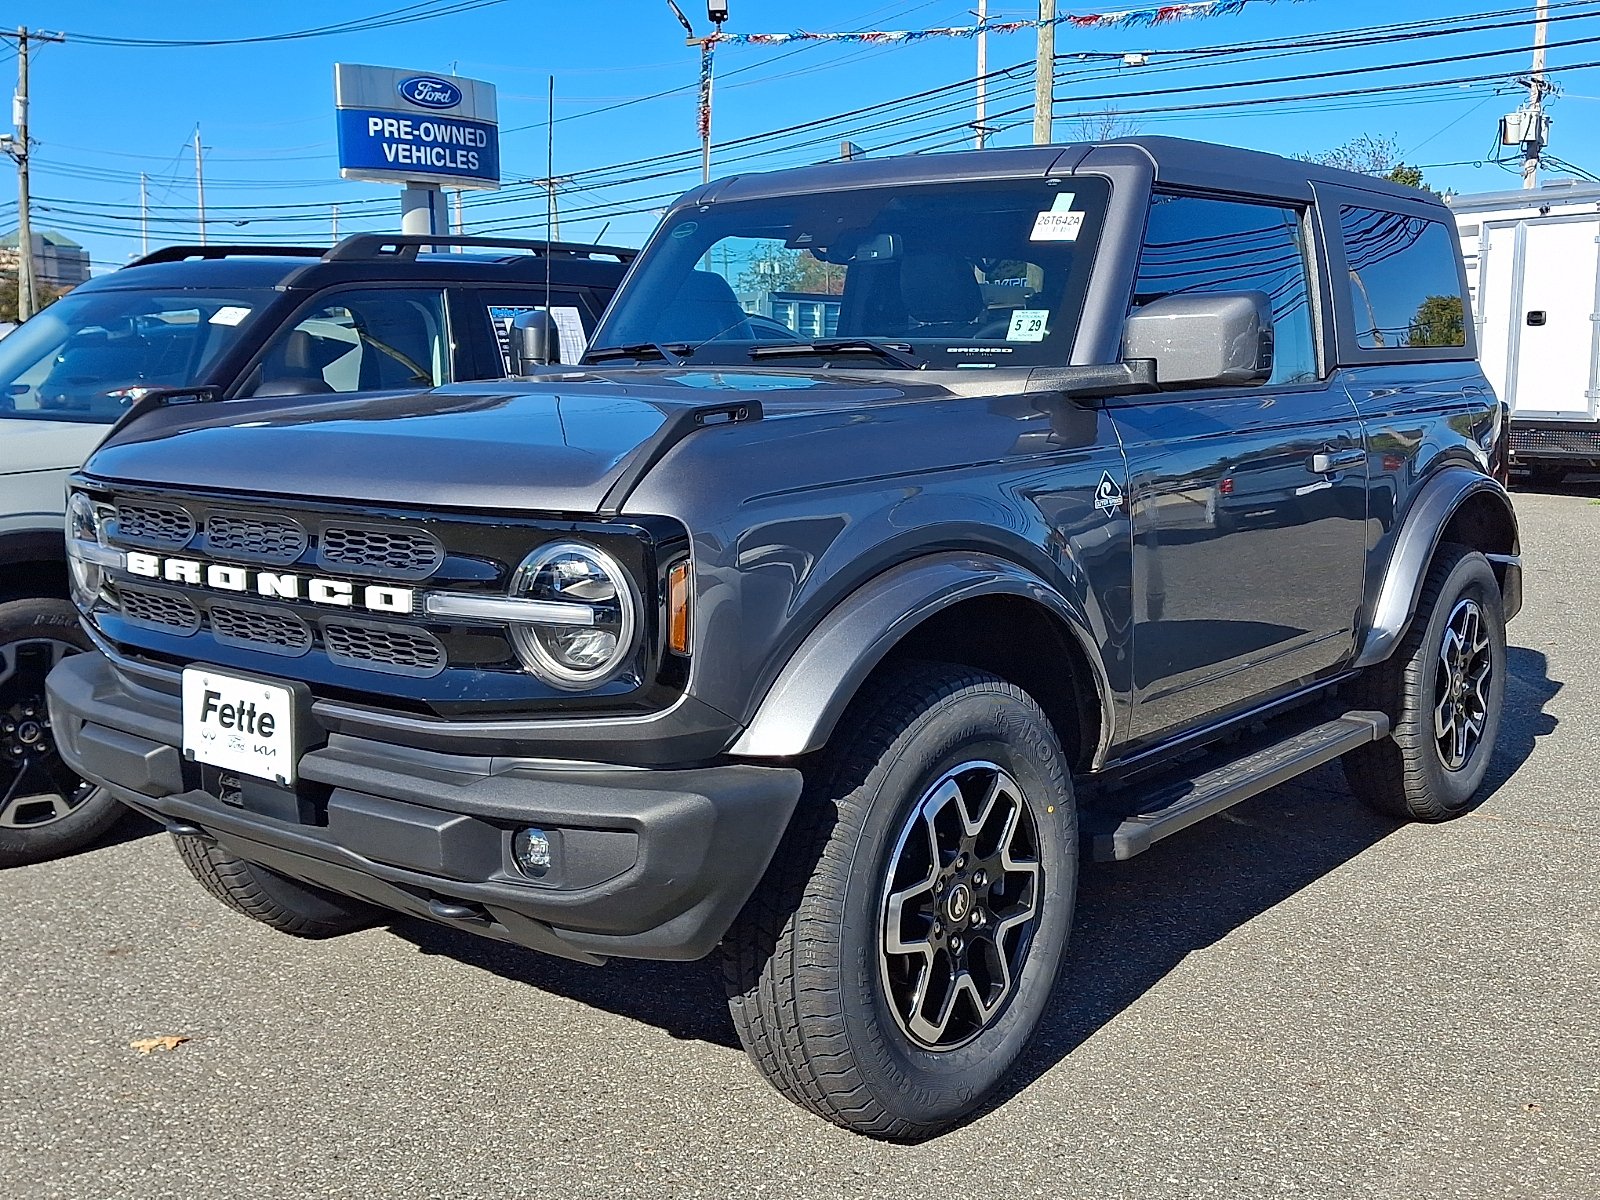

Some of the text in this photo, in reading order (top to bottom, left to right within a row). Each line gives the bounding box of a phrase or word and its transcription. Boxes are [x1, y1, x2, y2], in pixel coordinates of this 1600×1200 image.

[414, 81, 451, 103] Ford
[368, 117, 487, 148] PRE-OWNED
[382, 142, 480, 170] VEHICLES
[1038, 216, 1080, 226] 26T642A
[1014, 319, 1042, 332] 5 29
[126, 551, 413, 613] BRONCO
[200, 690, 275, 738] Fette
